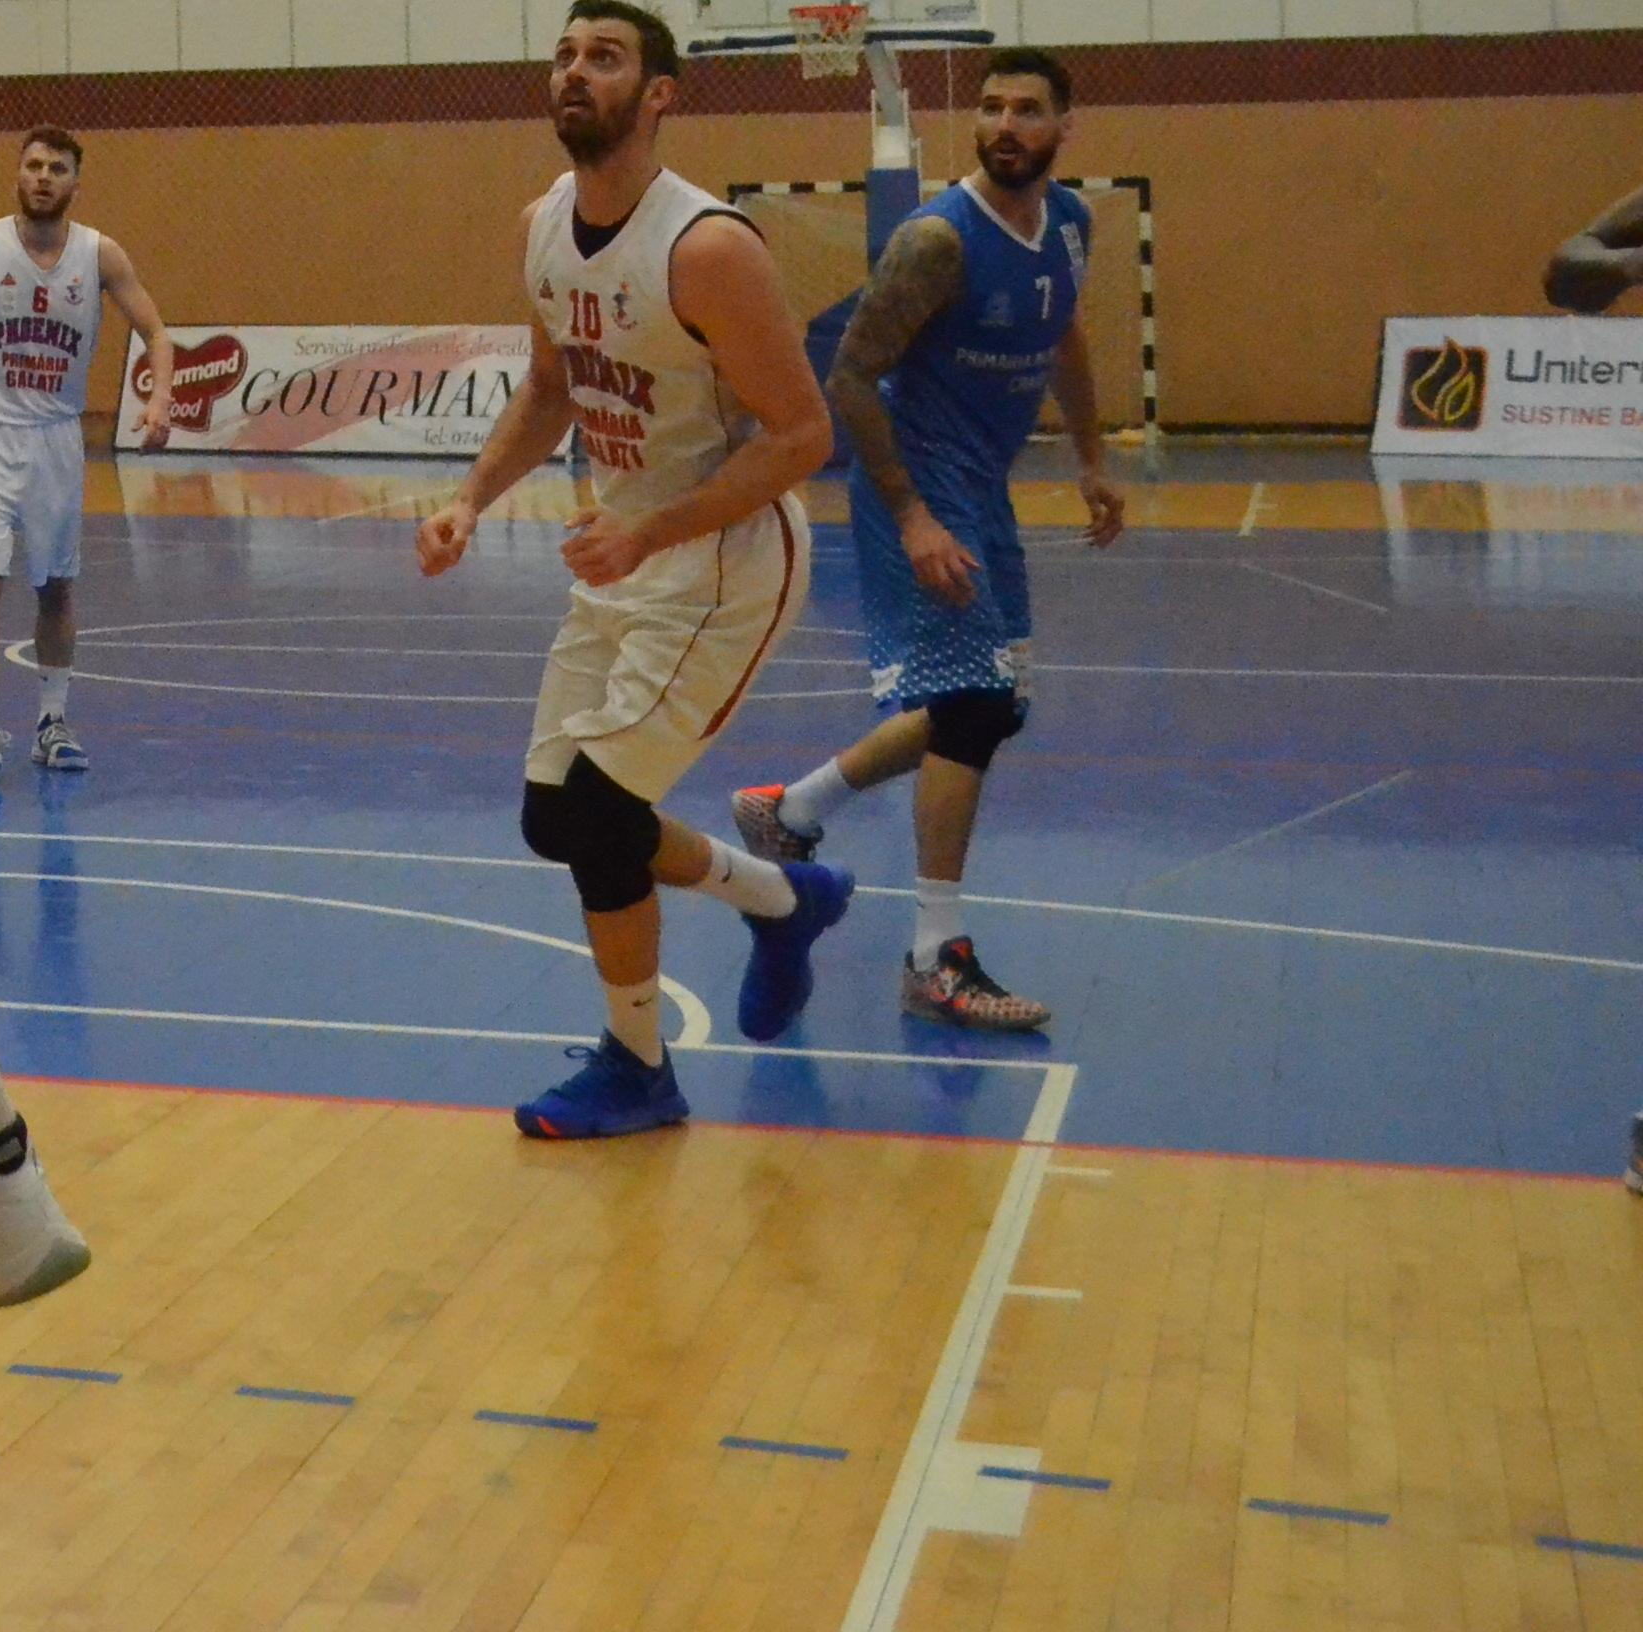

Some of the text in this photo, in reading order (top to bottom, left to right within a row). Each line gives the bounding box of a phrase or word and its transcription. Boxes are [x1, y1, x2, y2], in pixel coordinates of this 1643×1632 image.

[31, 285, 50, 314] 6
[568, 287, 603, 342] 10
[1034, 274, 1052, 320] 7
[136, 349, 240, 392] Grmand
[169, 397, 203, 418] ood
[241, 366, 514, 426] GOURMAN
